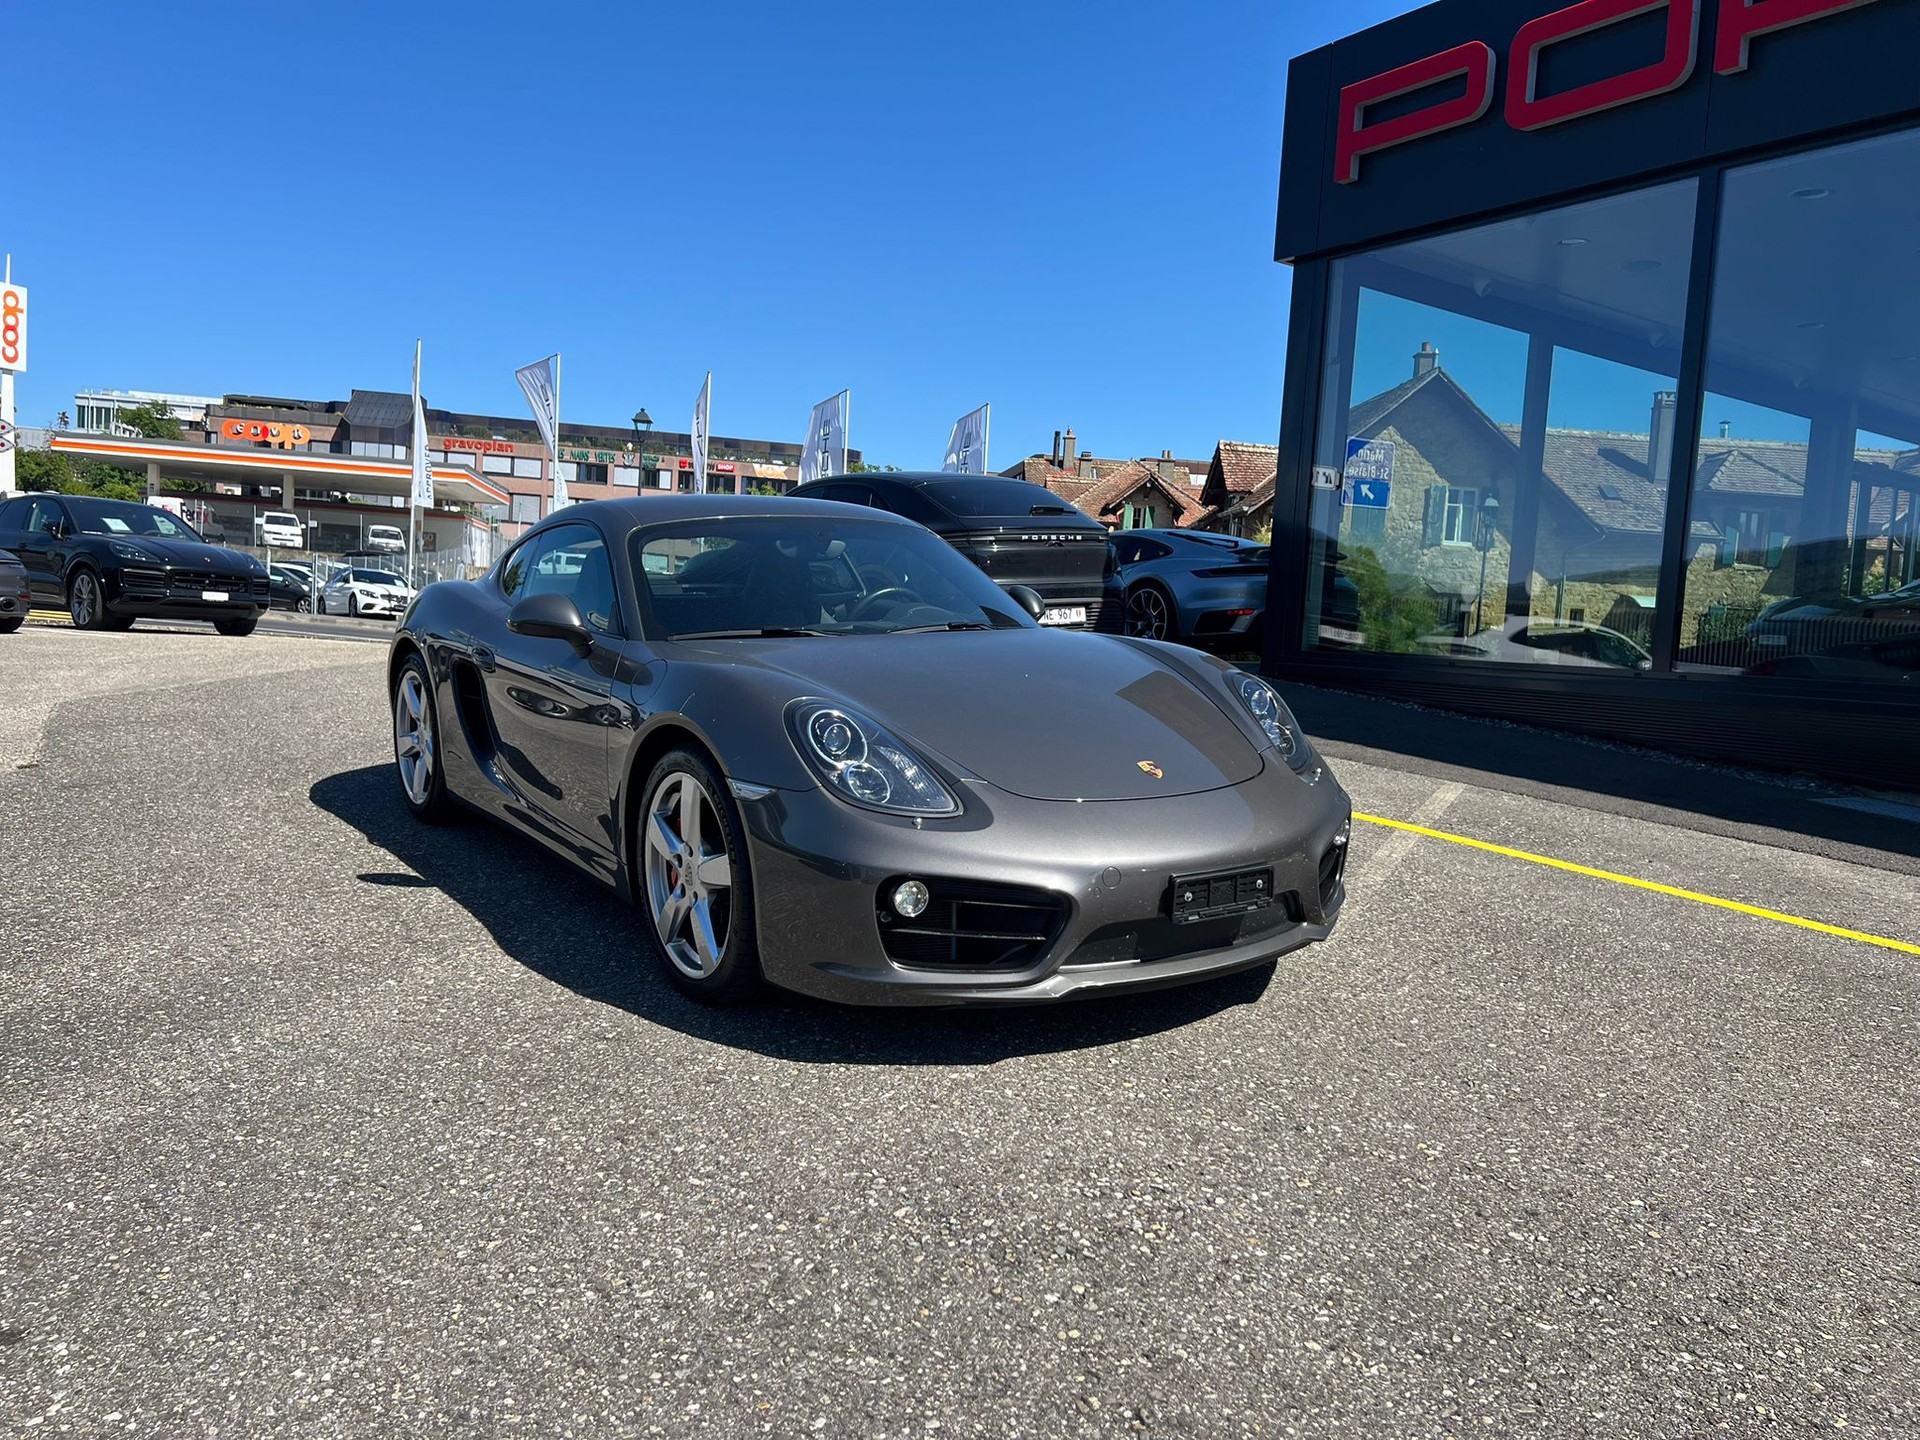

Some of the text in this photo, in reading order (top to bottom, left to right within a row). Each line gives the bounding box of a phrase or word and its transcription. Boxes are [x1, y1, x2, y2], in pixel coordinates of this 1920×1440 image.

[2, 290, 24, 363] coop
[222, 420, 311, 450] coop
[444, 437, 515, 453] gravoplan
[717, 463, 734, 471] SHOP
